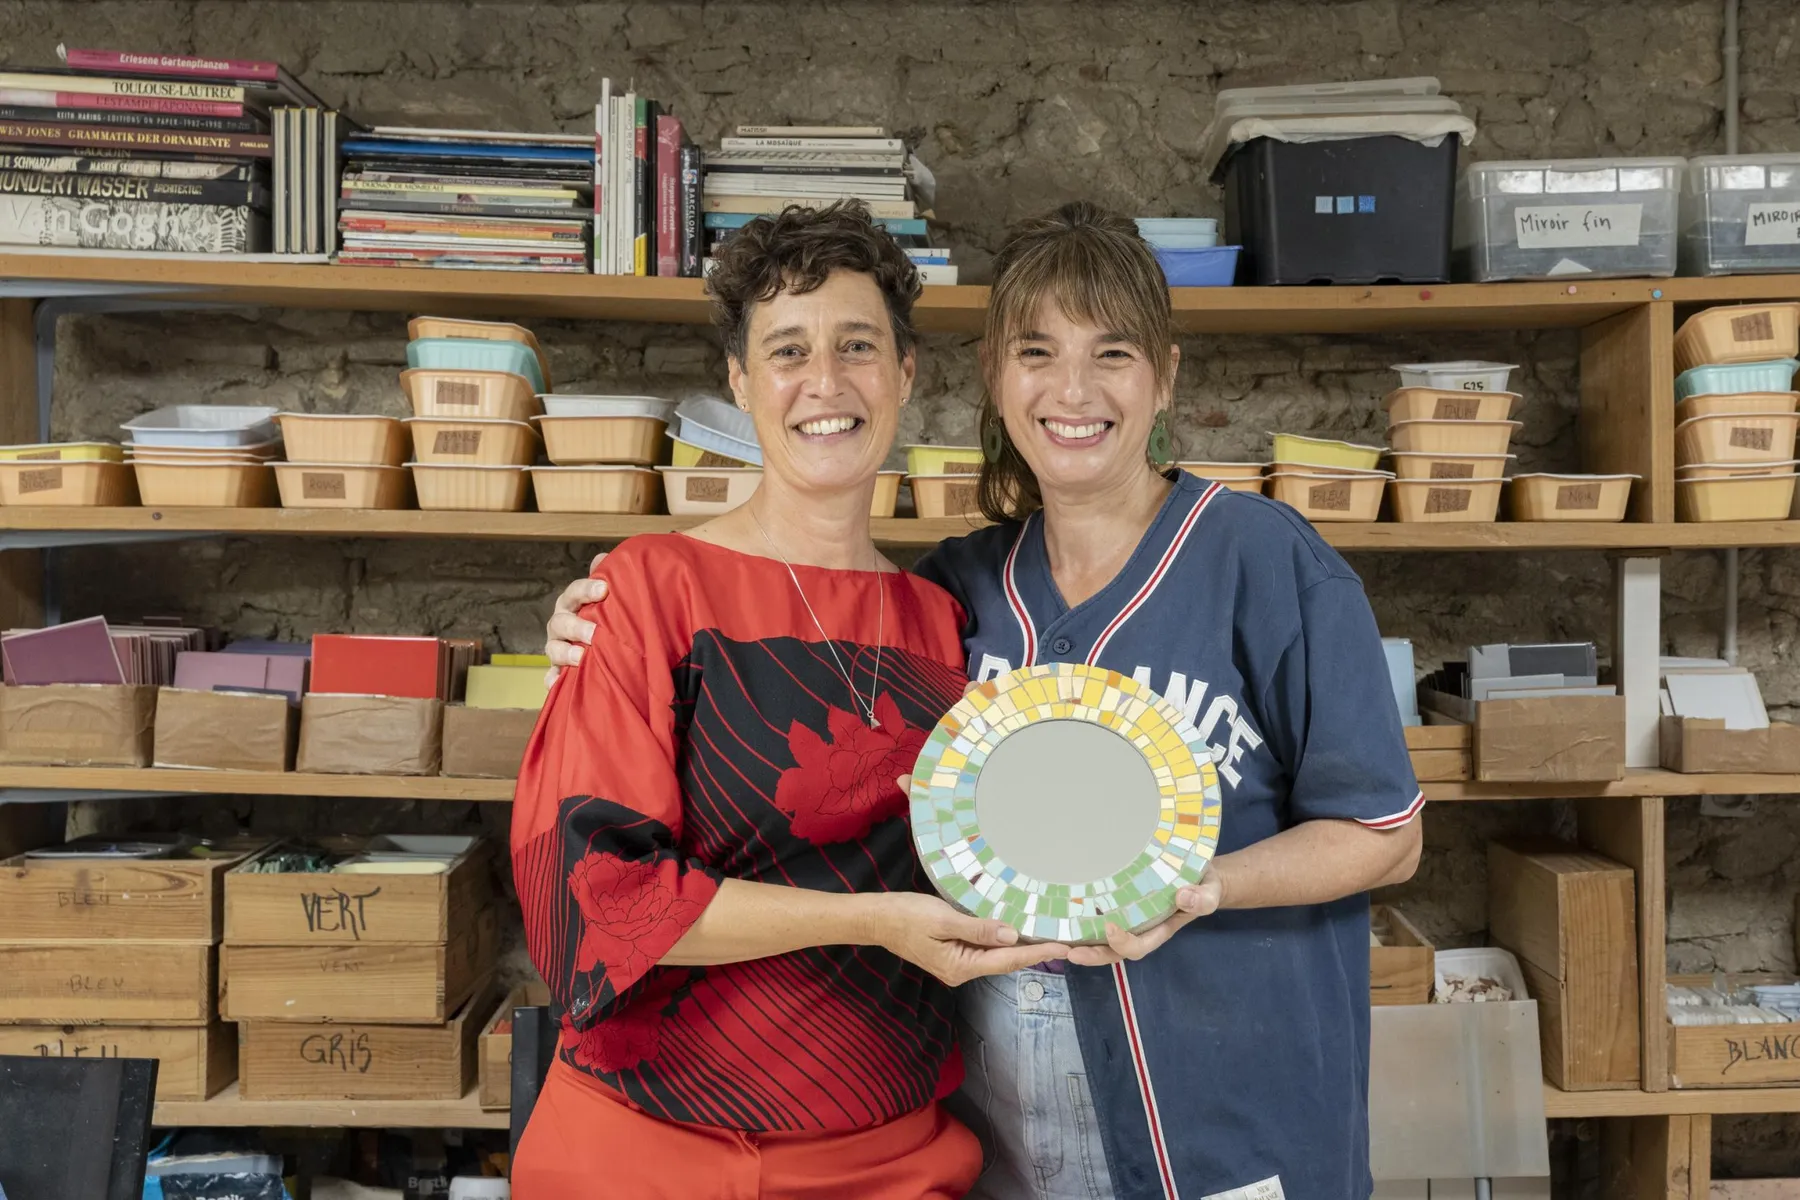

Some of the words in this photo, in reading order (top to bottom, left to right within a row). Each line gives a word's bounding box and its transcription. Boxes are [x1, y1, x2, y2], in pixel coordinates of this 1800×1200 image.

[119, 53, 159, 66] Erlesene
[161, 56, 230, 70] Gartenpflanzen
[112, 81, 236, 99] TOULOUSE-LAUTREC
[56, 111, 75, 120] KEITH
[78, 112, 102, 121] HARING
[107, 114, 141, 124] EDITIONS
[143, 117, 153, 125] ON
[157, 117, 178, 126] PAPER
[0, 125, 23, 137] WEN
[26, 127, 61, 138] JONES
[68, 129, 135, 143] GRAMMATIK
[137, 133, 160, 144] DER
[162, 135, 231, 148] ORNAMENTE
[766, 139, 802, 147] MOSAÏQUE
[74, 147, 132, 158] GAUGUIN
[89, 161, 118, 173] MASKEN
[81, 202, 180, 247] Gogh
[1520, 212, 1570, 234] Miroir
[1582, 210, 1611, 233] fin
[301, 887, 381, 941] VERT
[301, 1028, 372, 1074] GRIS
[1721, 1034, 1800, 1075] BLANC
